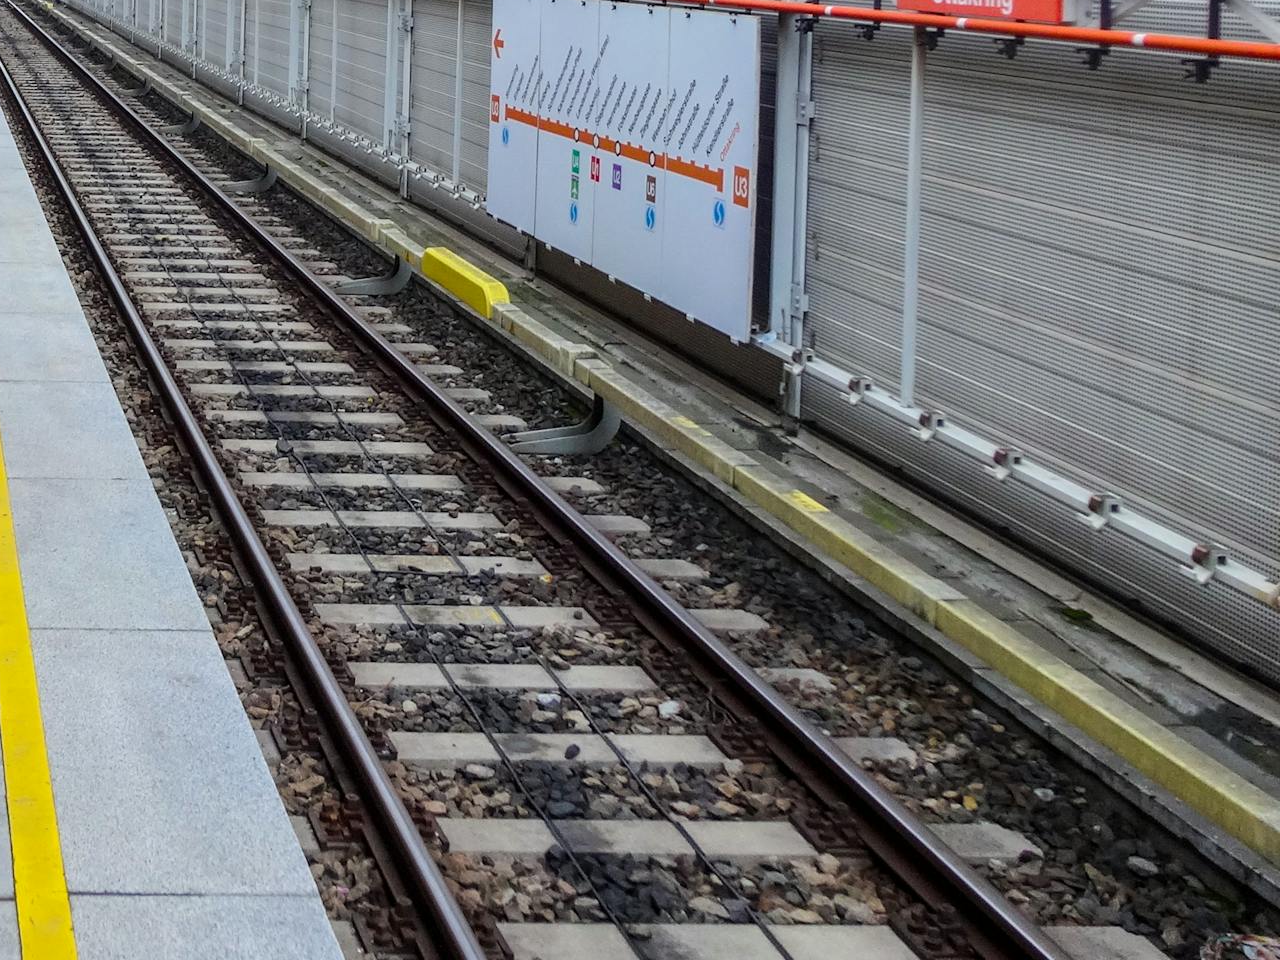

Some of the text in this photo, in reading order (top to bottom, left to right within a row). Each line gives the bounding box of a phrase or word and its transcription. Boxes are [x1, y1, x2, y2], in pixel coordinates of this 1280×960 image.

[719, 121, 741, 162] Ottakring
[613, 170, 622, 185] U2
[647, 182, 656, 197] U6
[734, 176, 748, 198] U3
